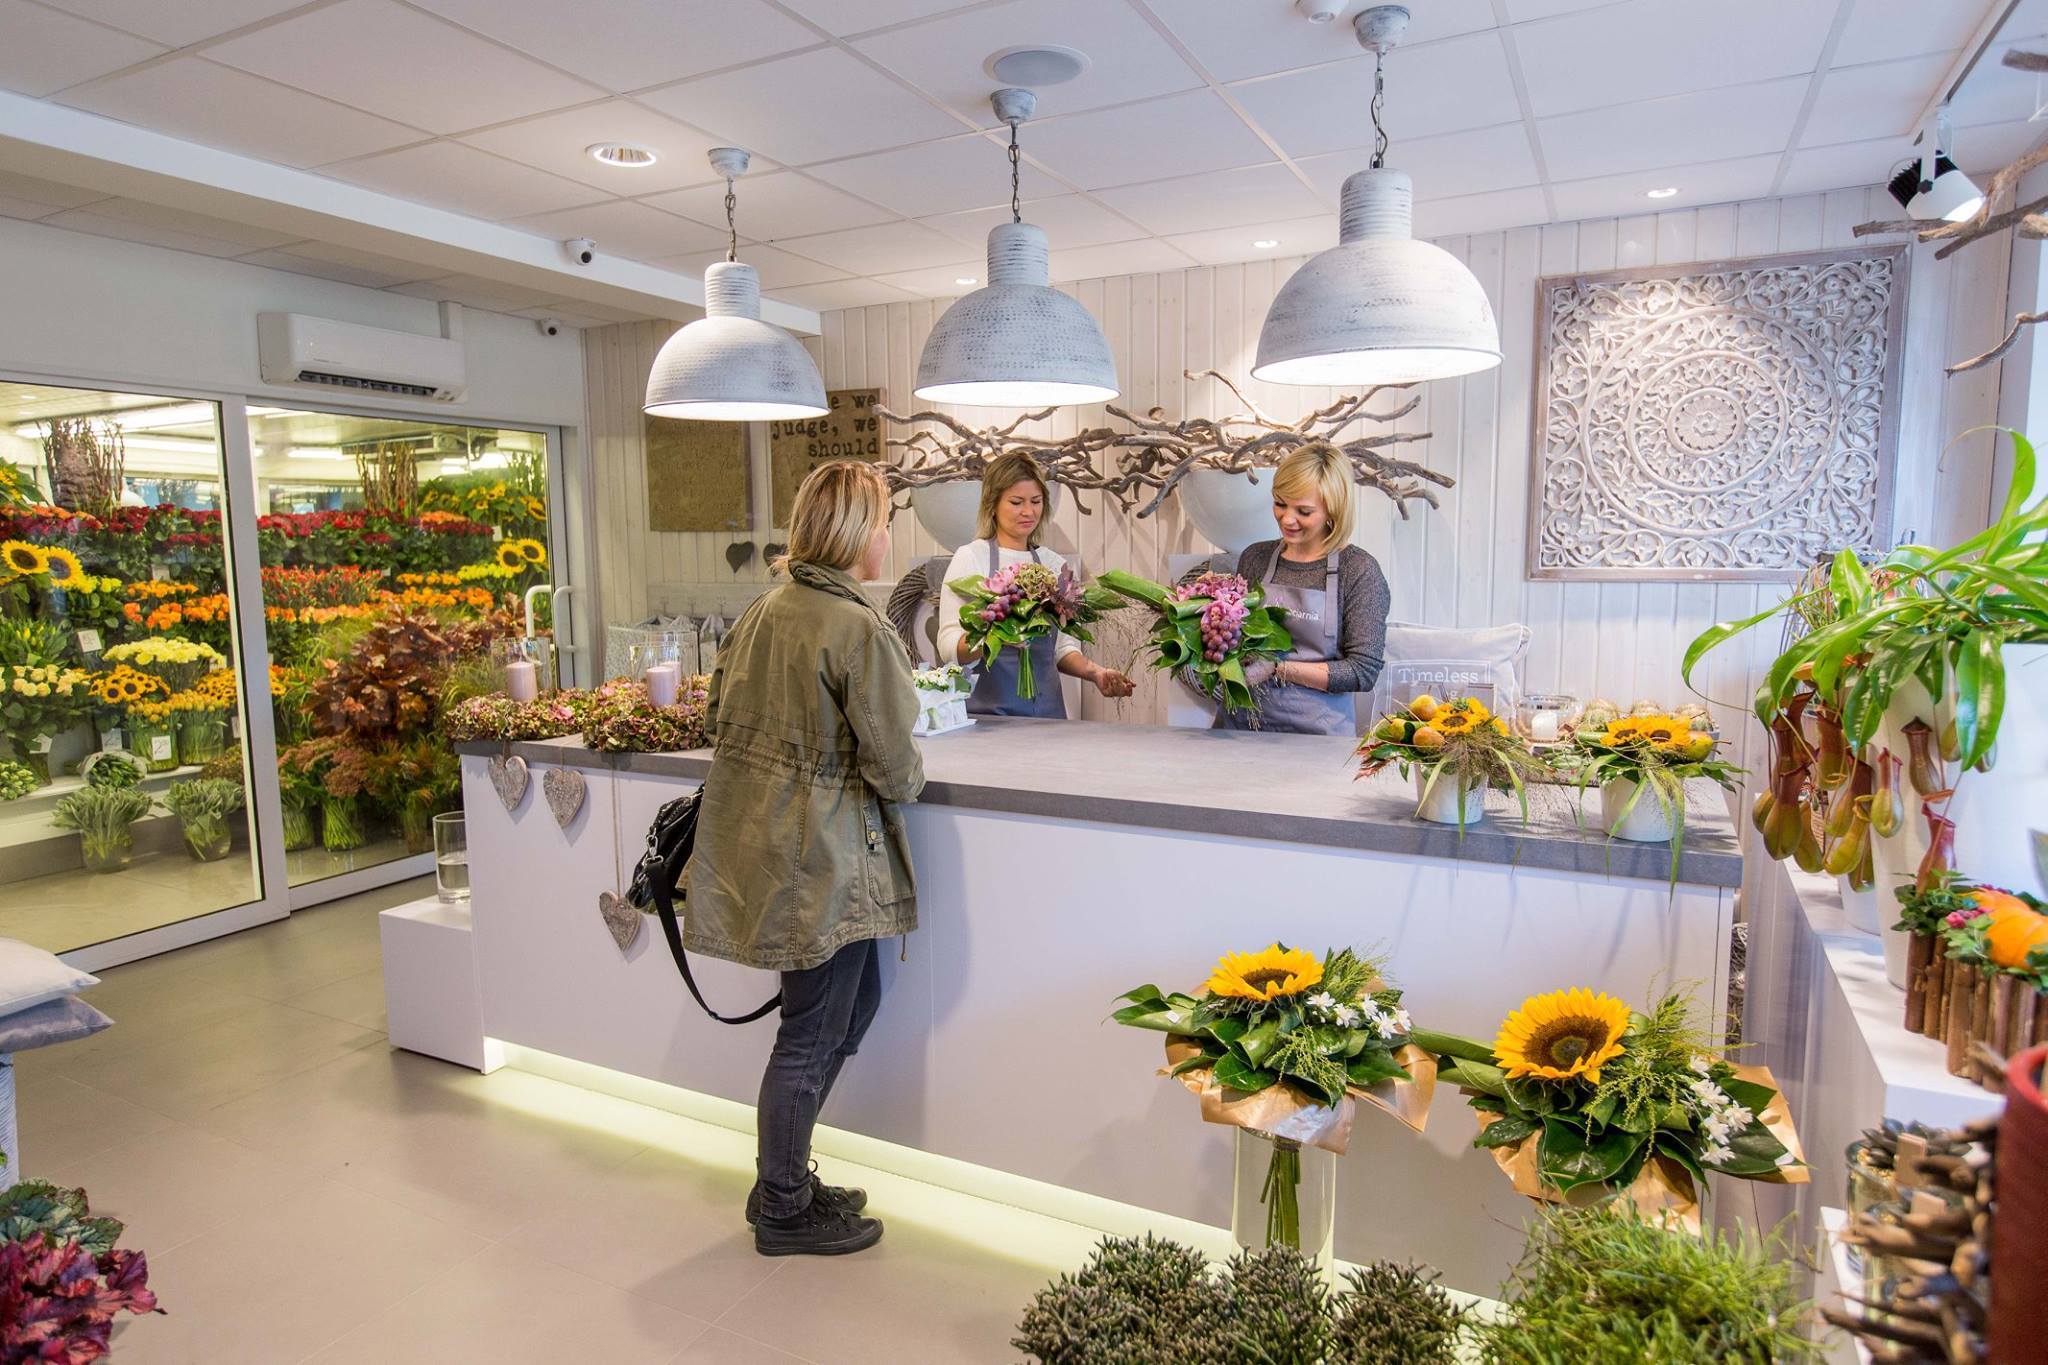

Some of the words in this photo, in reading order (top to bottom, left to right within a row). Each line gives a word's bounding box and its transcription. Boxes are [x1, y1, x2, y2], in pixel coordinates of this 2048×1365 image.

[852, 394, 877, 409] we
[772, 419, 839, 440] judge,
[853, 417, 878, 433] we
[808, 438, 880, 458] should
[1398, 665, 1479, 685] Timeless
